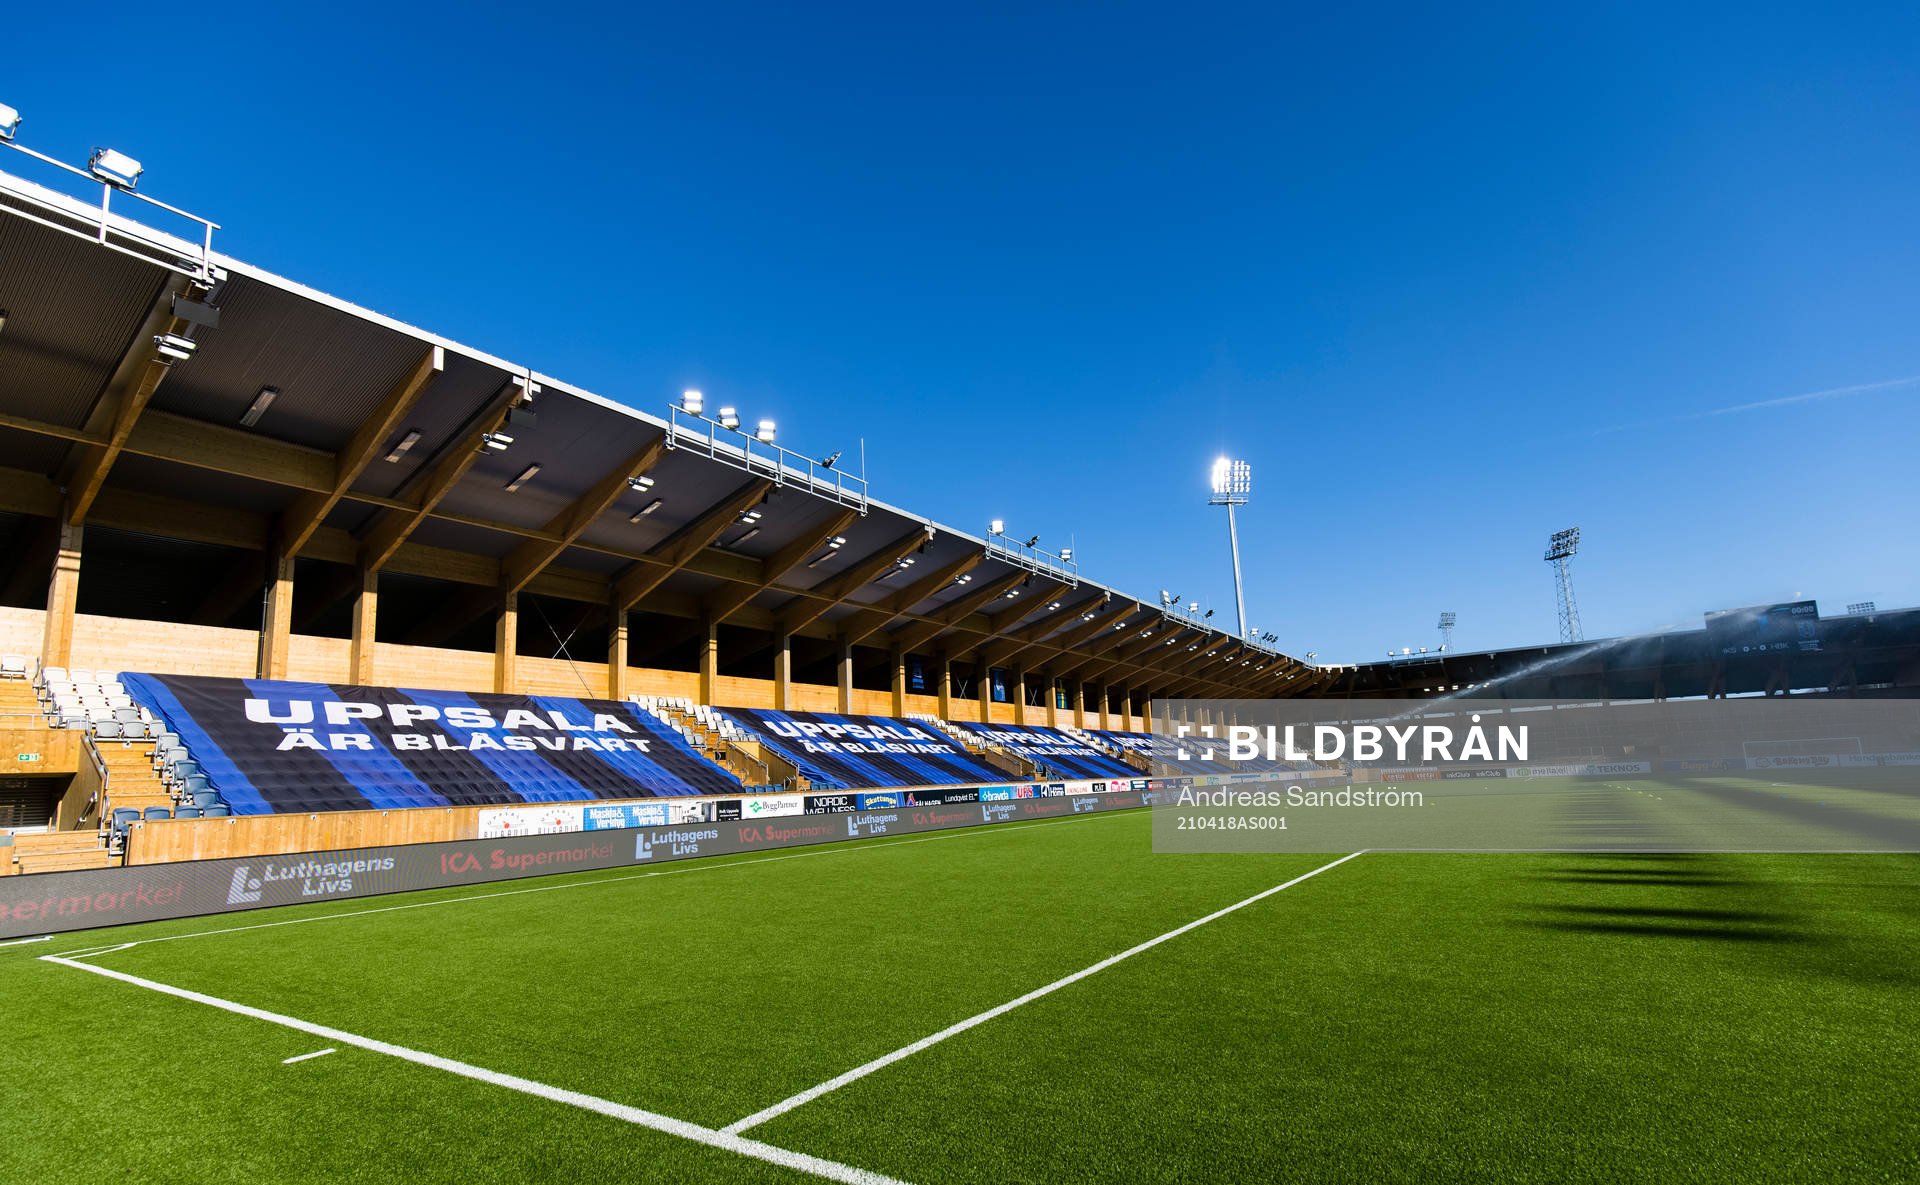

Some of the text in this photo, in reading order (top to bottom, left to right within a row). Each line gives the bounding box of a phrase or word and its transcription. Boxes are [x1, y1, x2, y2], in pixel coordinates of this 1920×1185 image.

[244, 698, 638, 734] UPPSALA
[763, 720, 938, 741] UPPSALA
[975, 730, 1084, 746] UPPSALA
[275, 728, 651, 753] ÄR BLÅSVART
[798, 739, 957, 755] ÄR BLÅSVART
[1597, 764, 1641, 774] TEKNOS
[762, 801, 798, 811] ByggPartner
[813, 796, 848, 807] NORDIC
[857, 813, 898, 826] Luthagens
[651, 828, 718, 845] Luthagens
[738, 828, 763, 844] ICA
[870, 823, 887, 834] Livs
[672, 843, 698, 856] Livs
[440, 841, 615, 875] ICA Supermarket
[264, 857, 395, 882] Luthagens
[302, 877, 353, 896] Livs
